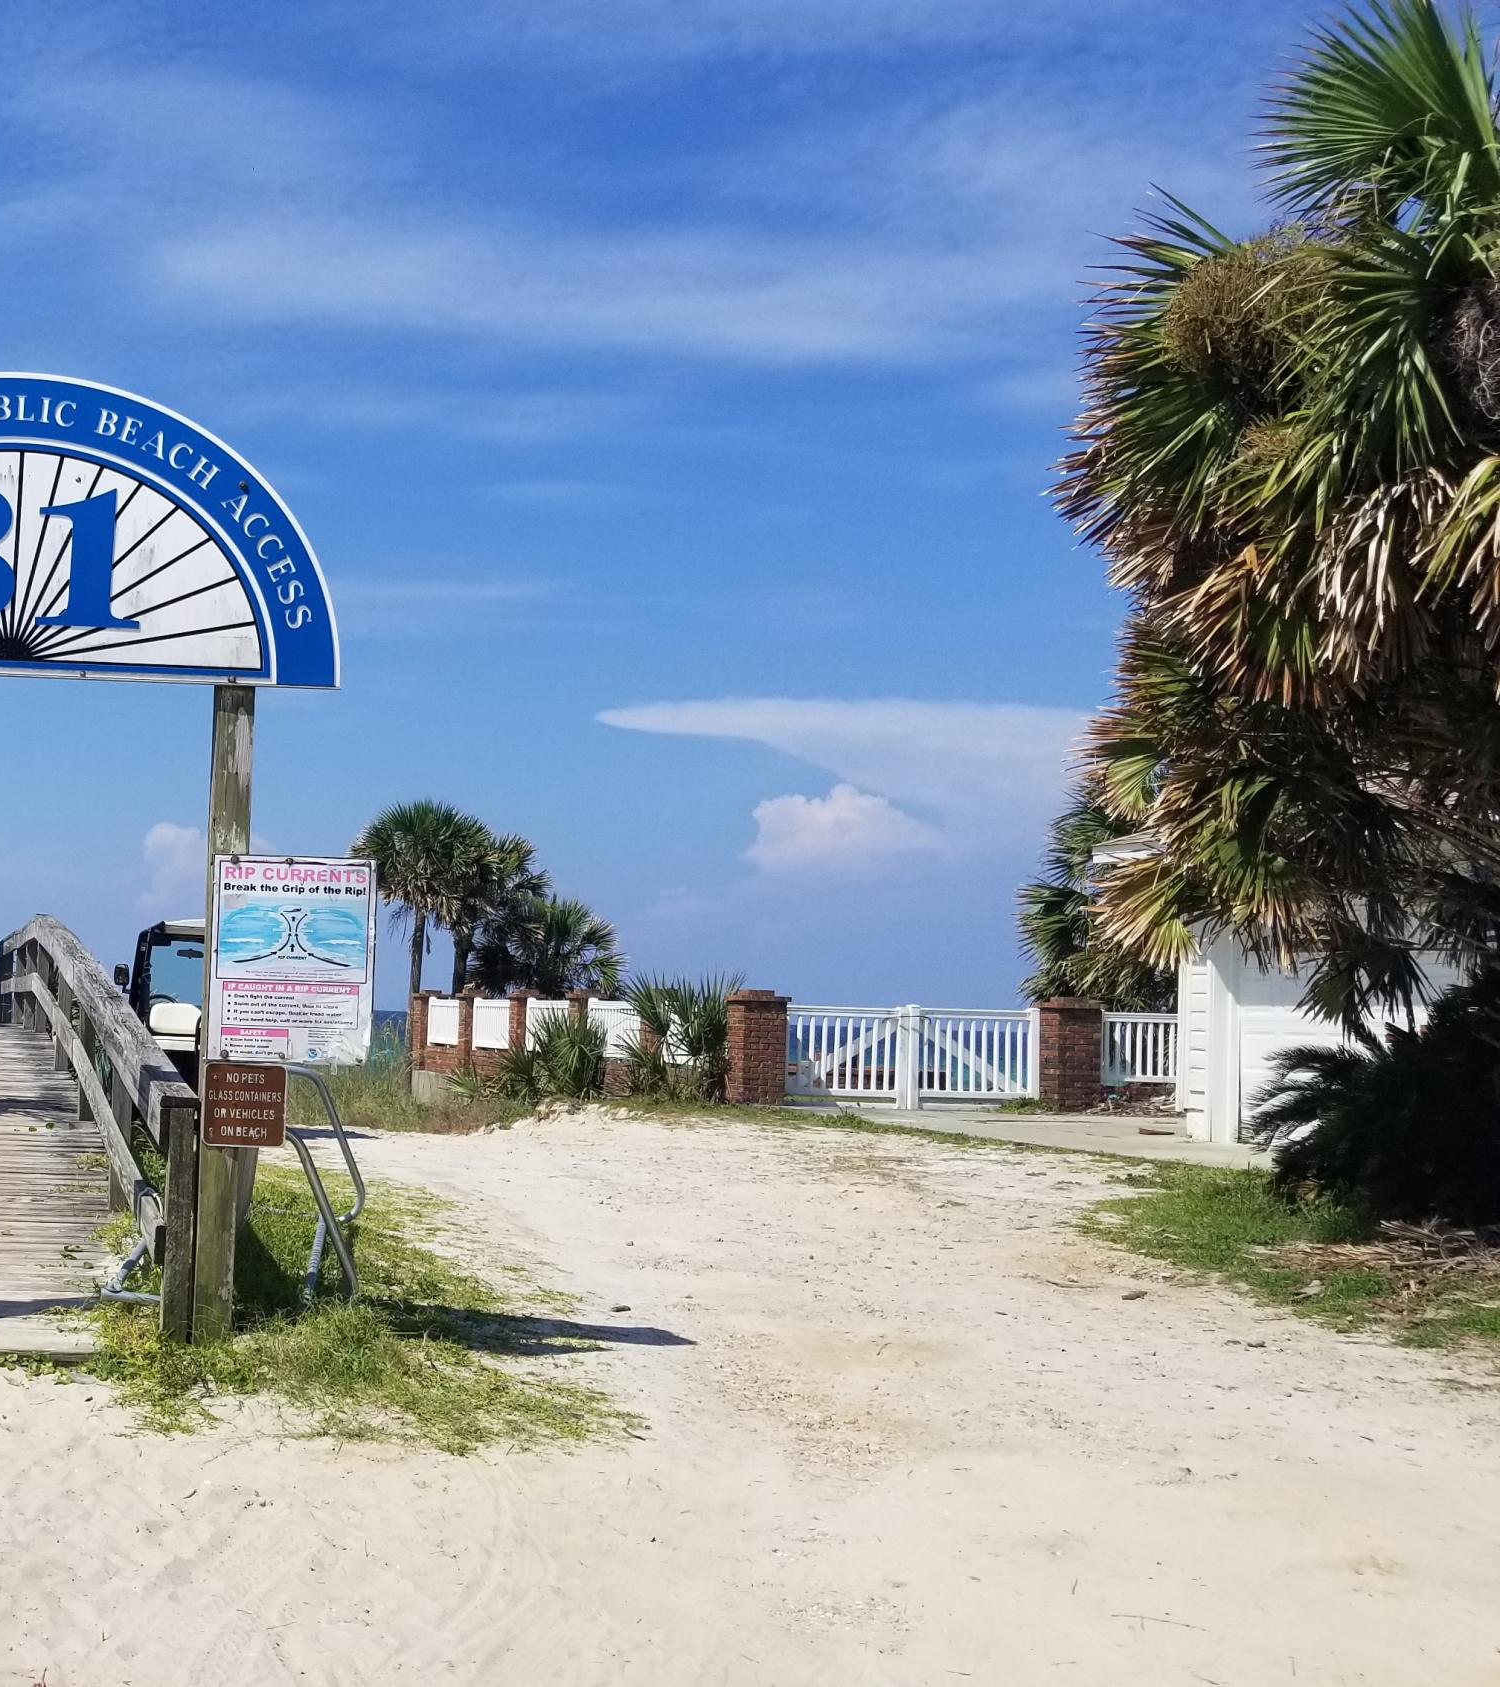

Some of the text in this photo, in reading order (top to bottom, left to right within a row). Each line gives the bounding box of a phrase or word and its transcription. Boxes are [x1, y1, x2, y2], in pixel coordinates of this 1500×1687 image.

[93, 408, 221, 490] BEACH
[220, 492, 312, 629] ACCESS
[224, 865, 367, 884] RIP CURRENTS
[223, 882, 367, 897] Break the Grip of the Rip!
[226, 1072, 265, 1084] NO PETS
[208, 1090, 282, 1102] GLASS CONTAINERS
[214, 1107, 275, 1120] OR VEHICLES
[220, 1126, 267, 1138] ON BEACH
